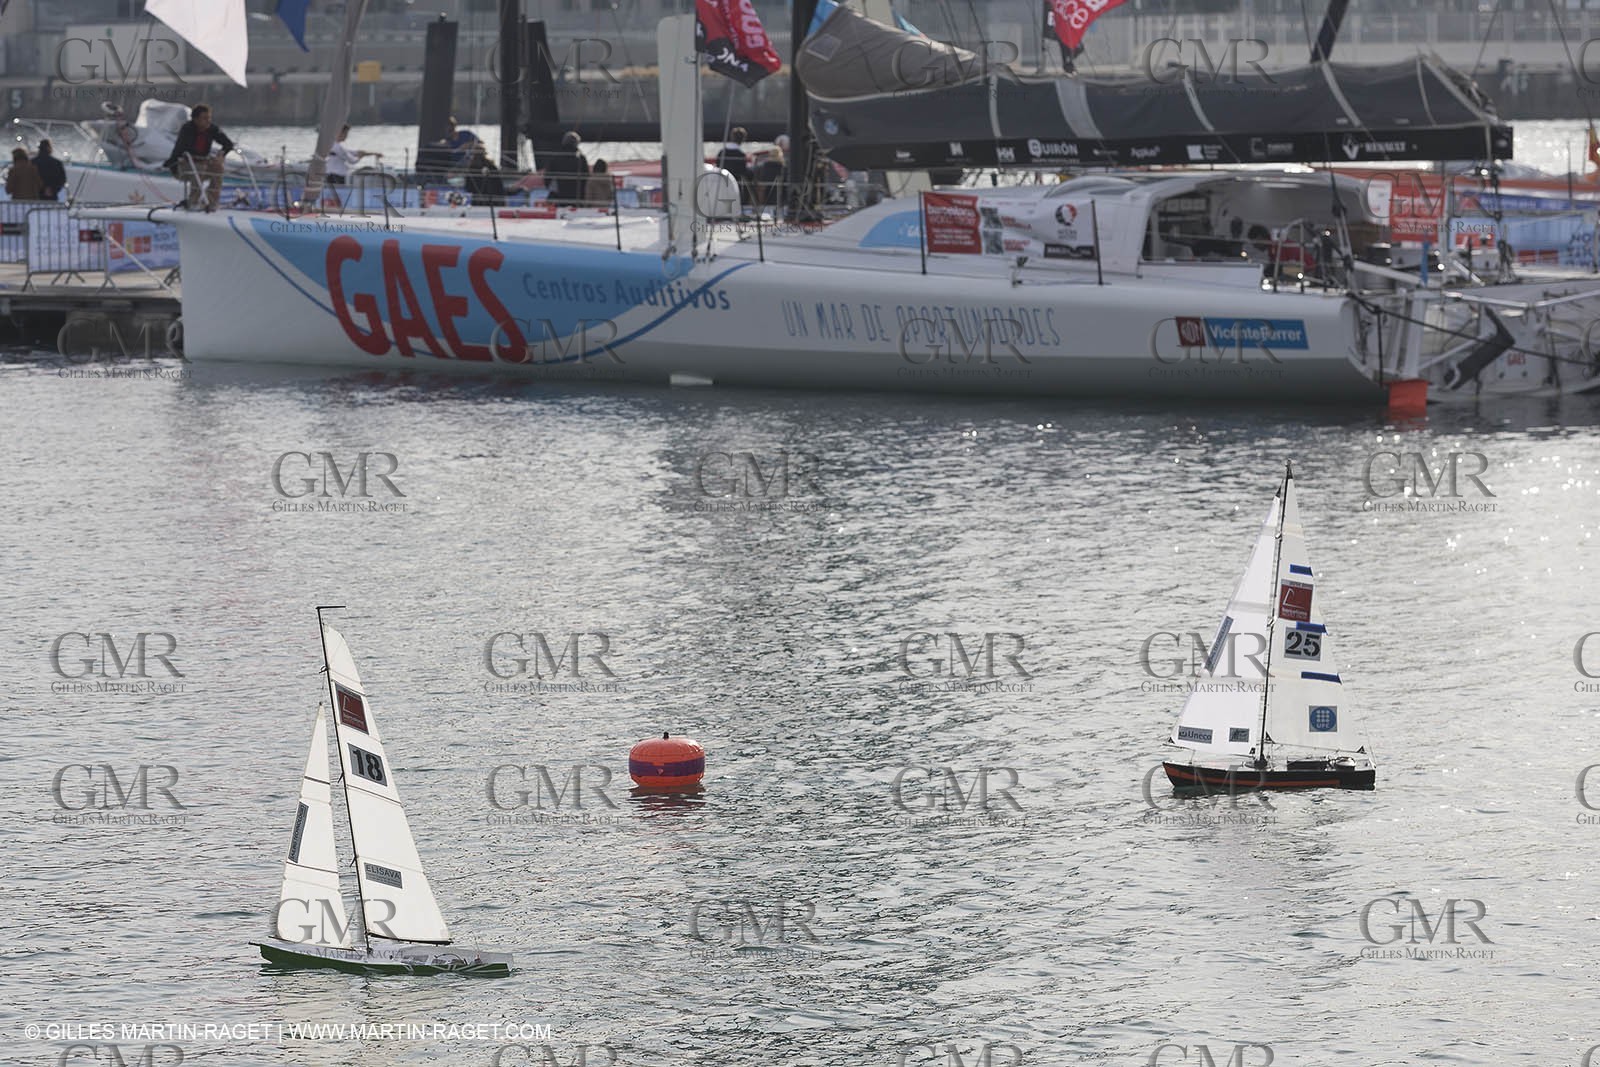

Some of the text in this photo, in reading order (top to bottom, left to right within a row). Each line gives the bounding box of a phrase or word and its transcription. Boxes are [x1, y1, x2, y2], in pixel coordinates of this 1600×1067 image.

[1365, 141, 1406, 152] RENAULT
[326, 235, 530, 364] GAES
[523, 273, 730, 310] Centros Auditivos
[783, 300, 808, 337] UN
[815, 302, 856, 341] MAR
[862, 303, 892, 342] DE
[1285, 631, 1320, 657] 25
[352, 749, 383, 781] 18
[365, 863, 402, 879] ELISAVA
